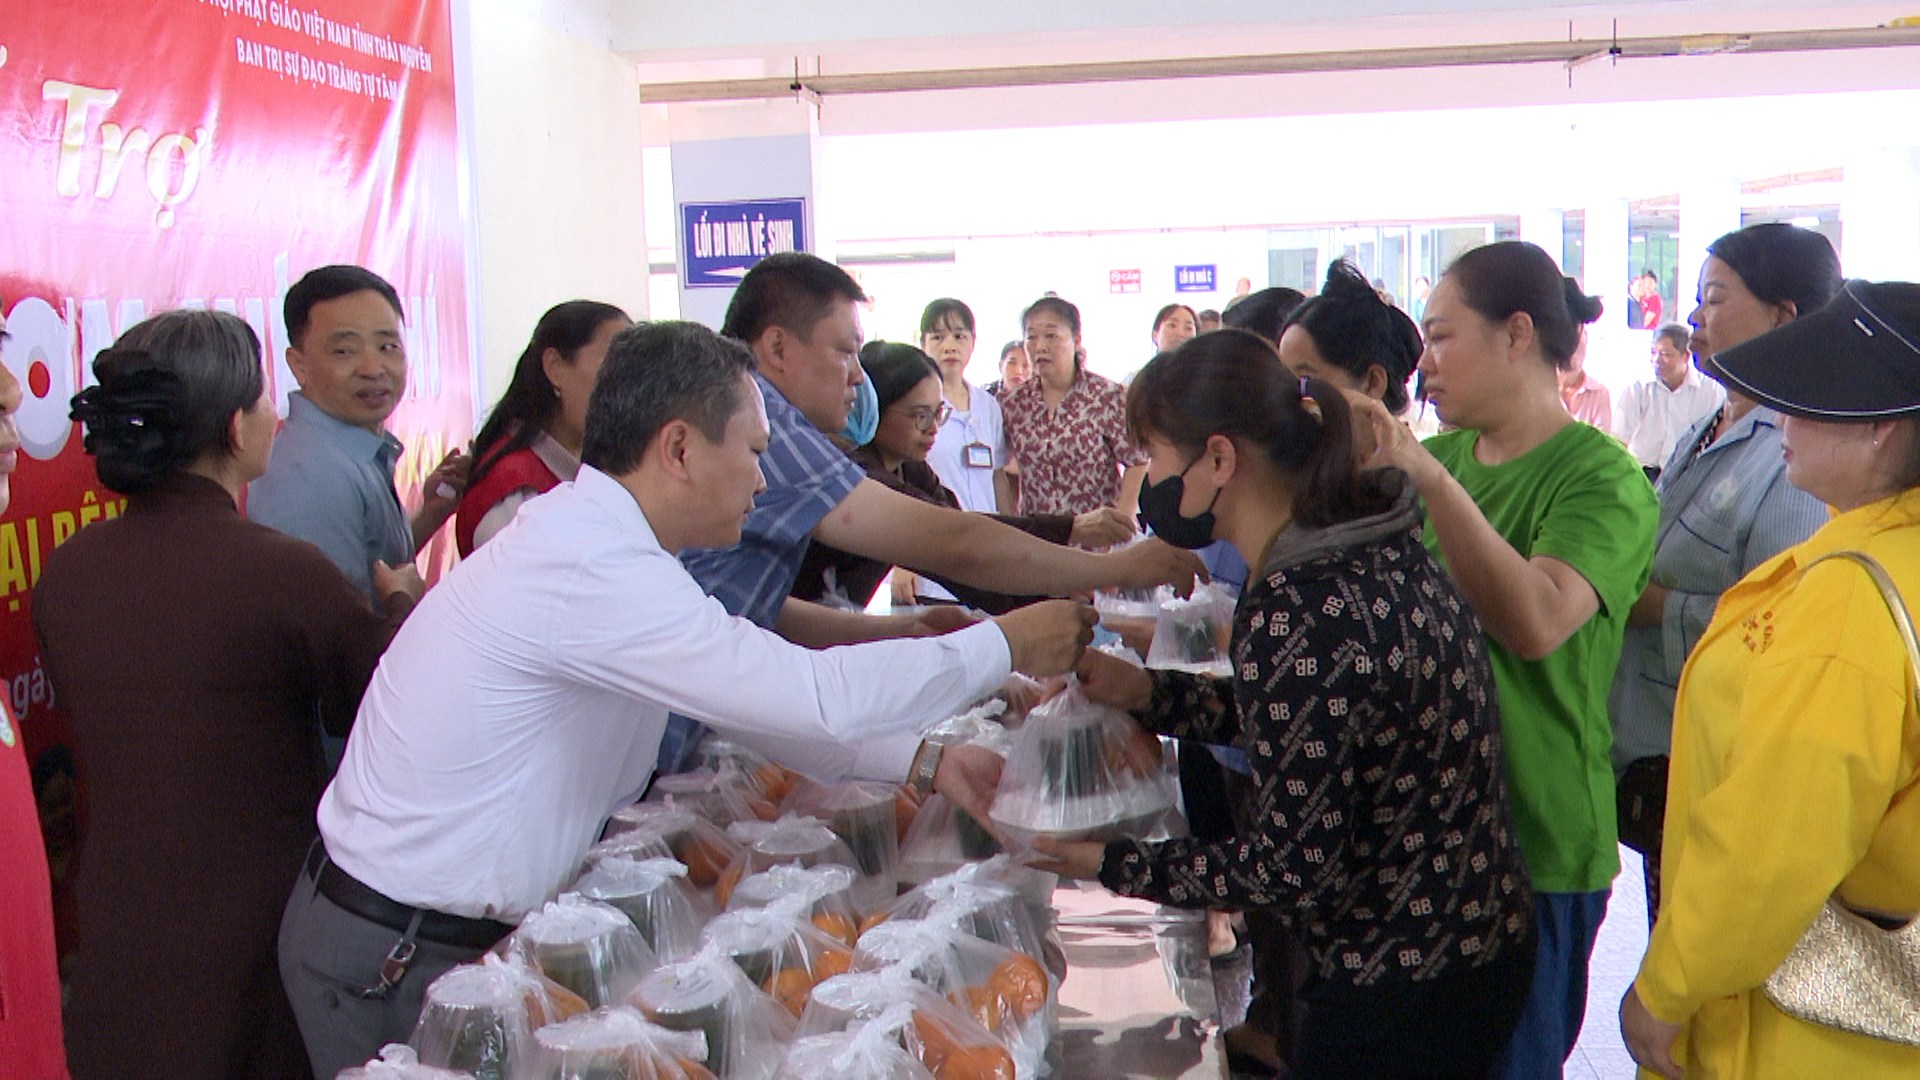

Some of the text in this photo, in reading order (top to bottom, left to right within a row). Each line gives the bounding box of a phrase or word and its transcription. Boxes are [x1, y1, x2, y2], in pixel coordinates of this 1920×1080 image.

[236, 37, 264, 68] BAN
[263, 45, 285, 81] TRỊ
[301, 55, 327, 89] ĐẠO
[326, 60, 363, 95] TRÀNG
[269, 0, 302, 33] GIÁO
[302, 9, 326, 46] VIỆT
[326, 19, 352, 49] NAM
[374, 34, 400, 63] THÁI
[399, 45, 432, 73] NGUYÊN
[41, 78, 209, 229] Trợ
[693, 209, 713, 258] LỐI
[726, 213, 752, 257] NHÀ
[766, 218, 796, 256] SINH
